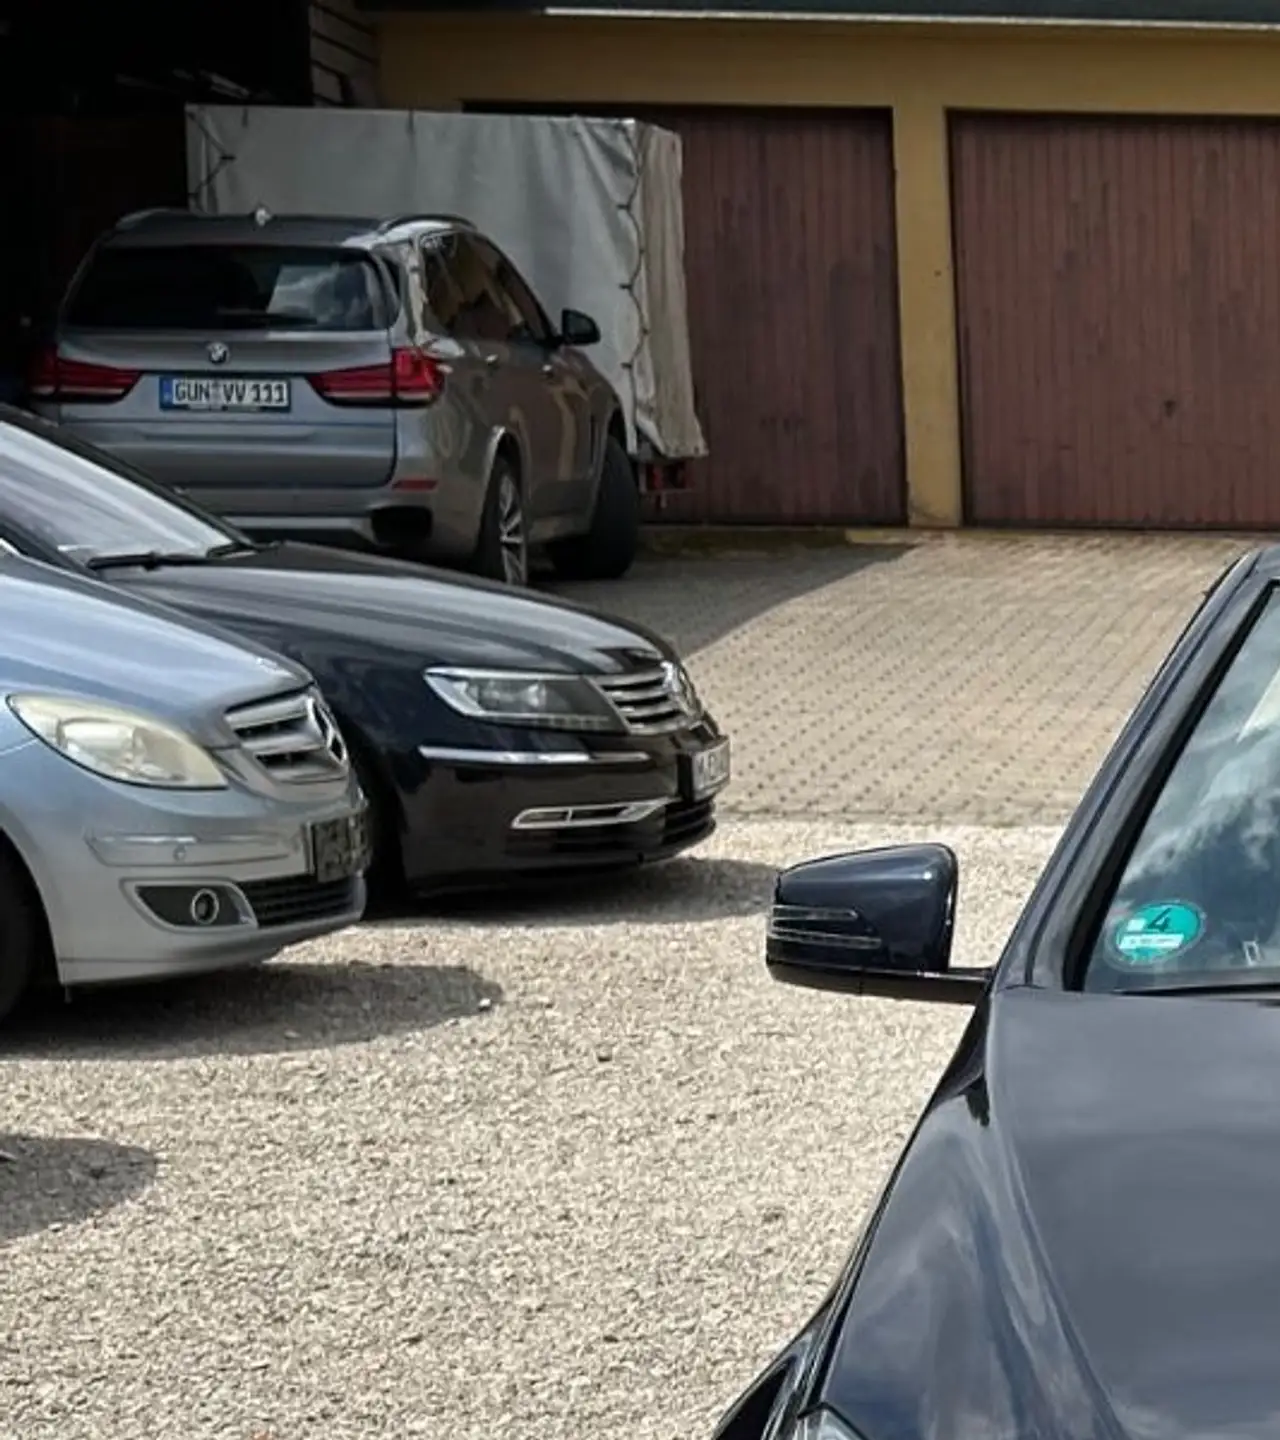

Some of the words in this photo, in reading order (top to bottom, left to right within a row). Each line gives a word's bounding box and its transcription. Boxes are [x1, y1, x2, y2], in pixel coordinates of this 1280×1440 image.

[175, 381, 210, 402] GUN
[223, 382, 247, 403] VV
[252, 383, 285, 404] 111
[1147, 907, 1172, 931] 4
